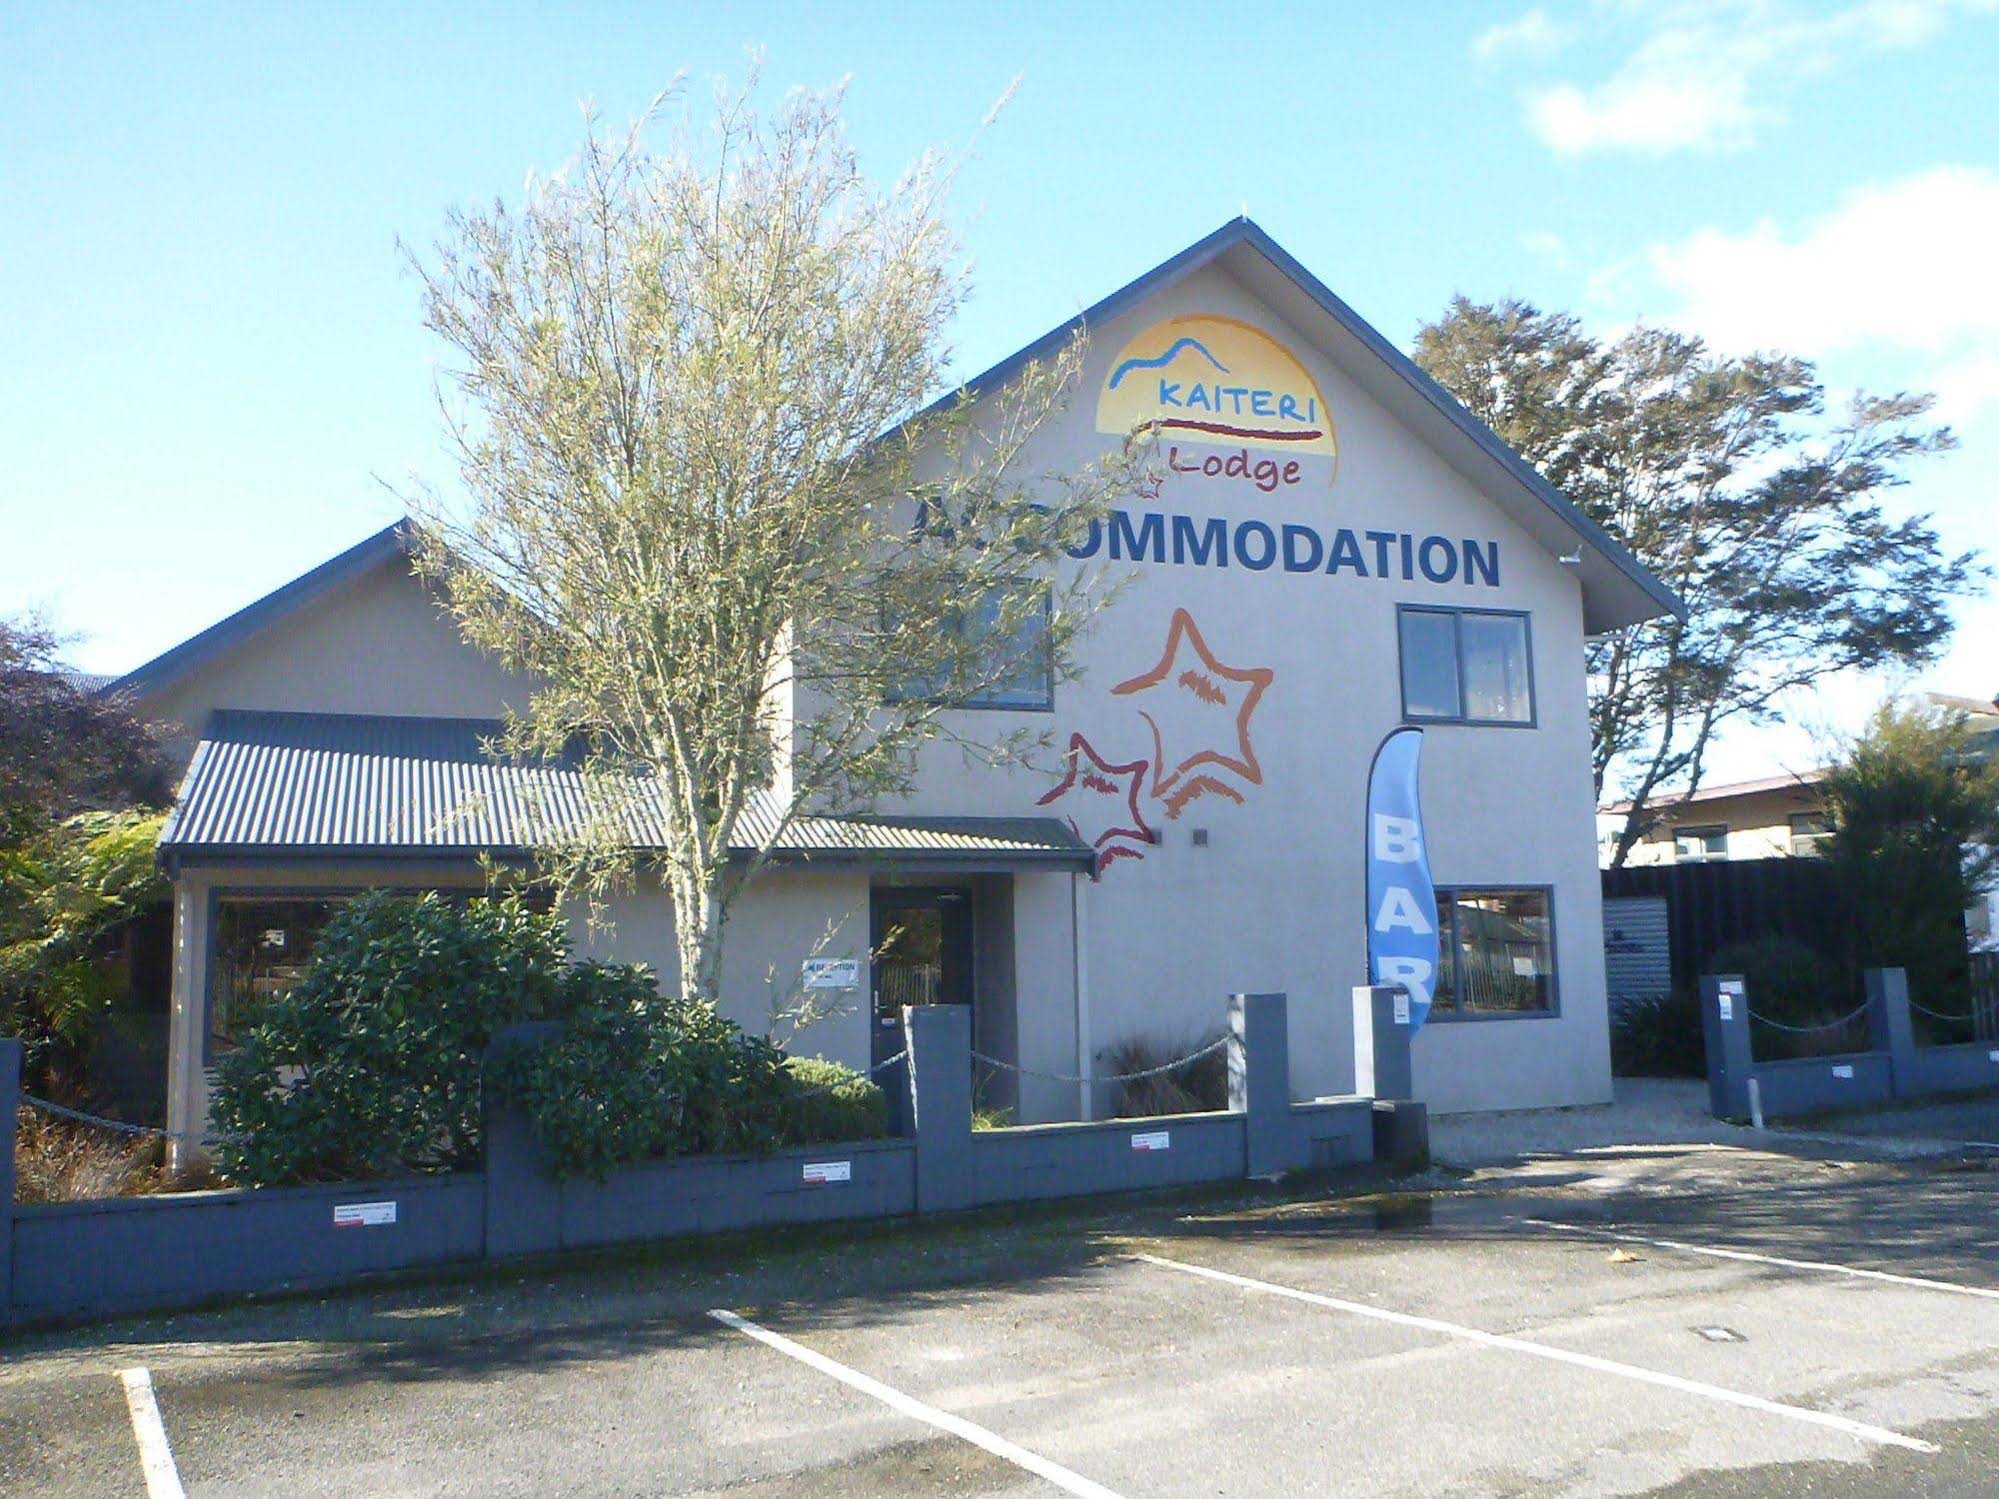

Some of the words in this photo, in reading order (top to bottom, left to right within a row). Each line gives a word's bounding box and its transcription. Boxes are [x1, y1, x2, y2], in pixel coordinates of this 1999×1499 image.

[1160, 378, 1315, 423] KAITERI
[1168, 447, 1300, 492] Lodge
[907, 496, 1500, 588] AOMMODATION
[1374, 813, 1433, 1004] BAR
[816, 963, 855, 971] REPTION
